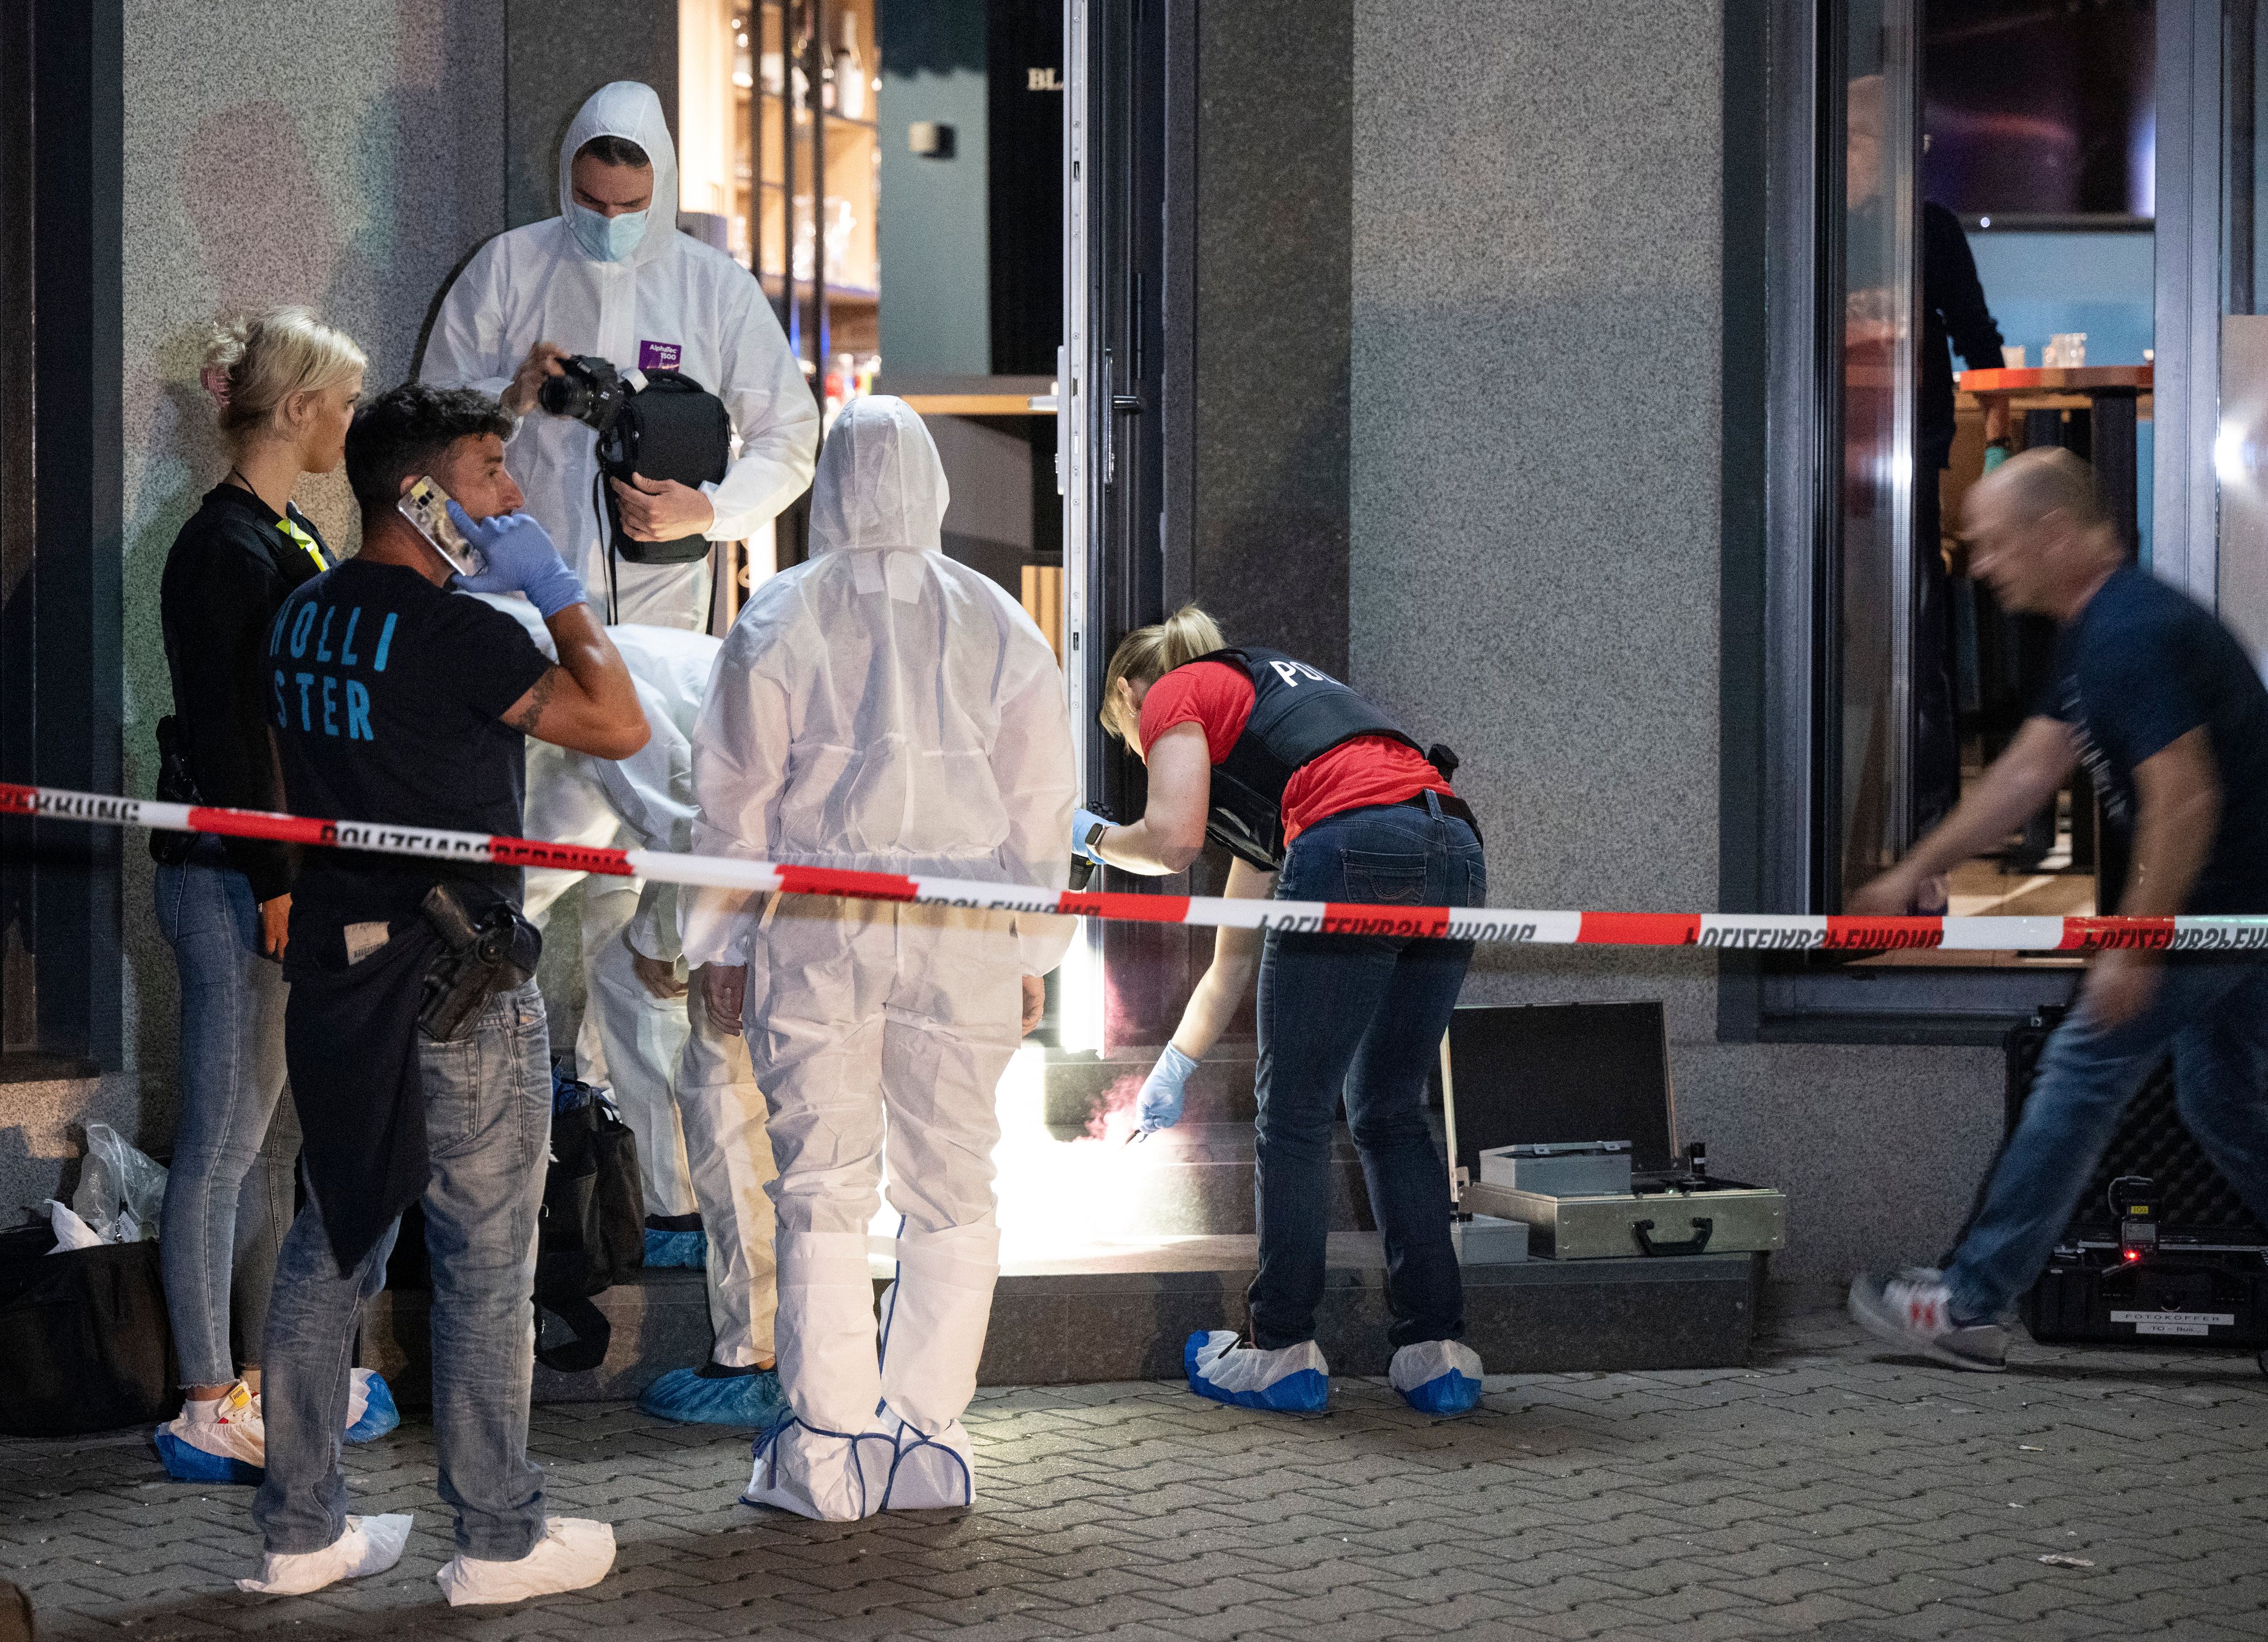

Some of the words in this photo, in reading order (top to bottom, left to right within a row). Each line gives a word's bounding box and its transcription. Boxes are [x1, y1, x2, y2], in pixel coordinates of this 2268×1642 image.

[1027, 67, 1064, 91] BL
[650, 345, 676, 353] AlphaTec
[661, 352, 676, 361] 1500
[270, 599, 398, 672] HOLLI
[274, 669, 374, 742] STER
